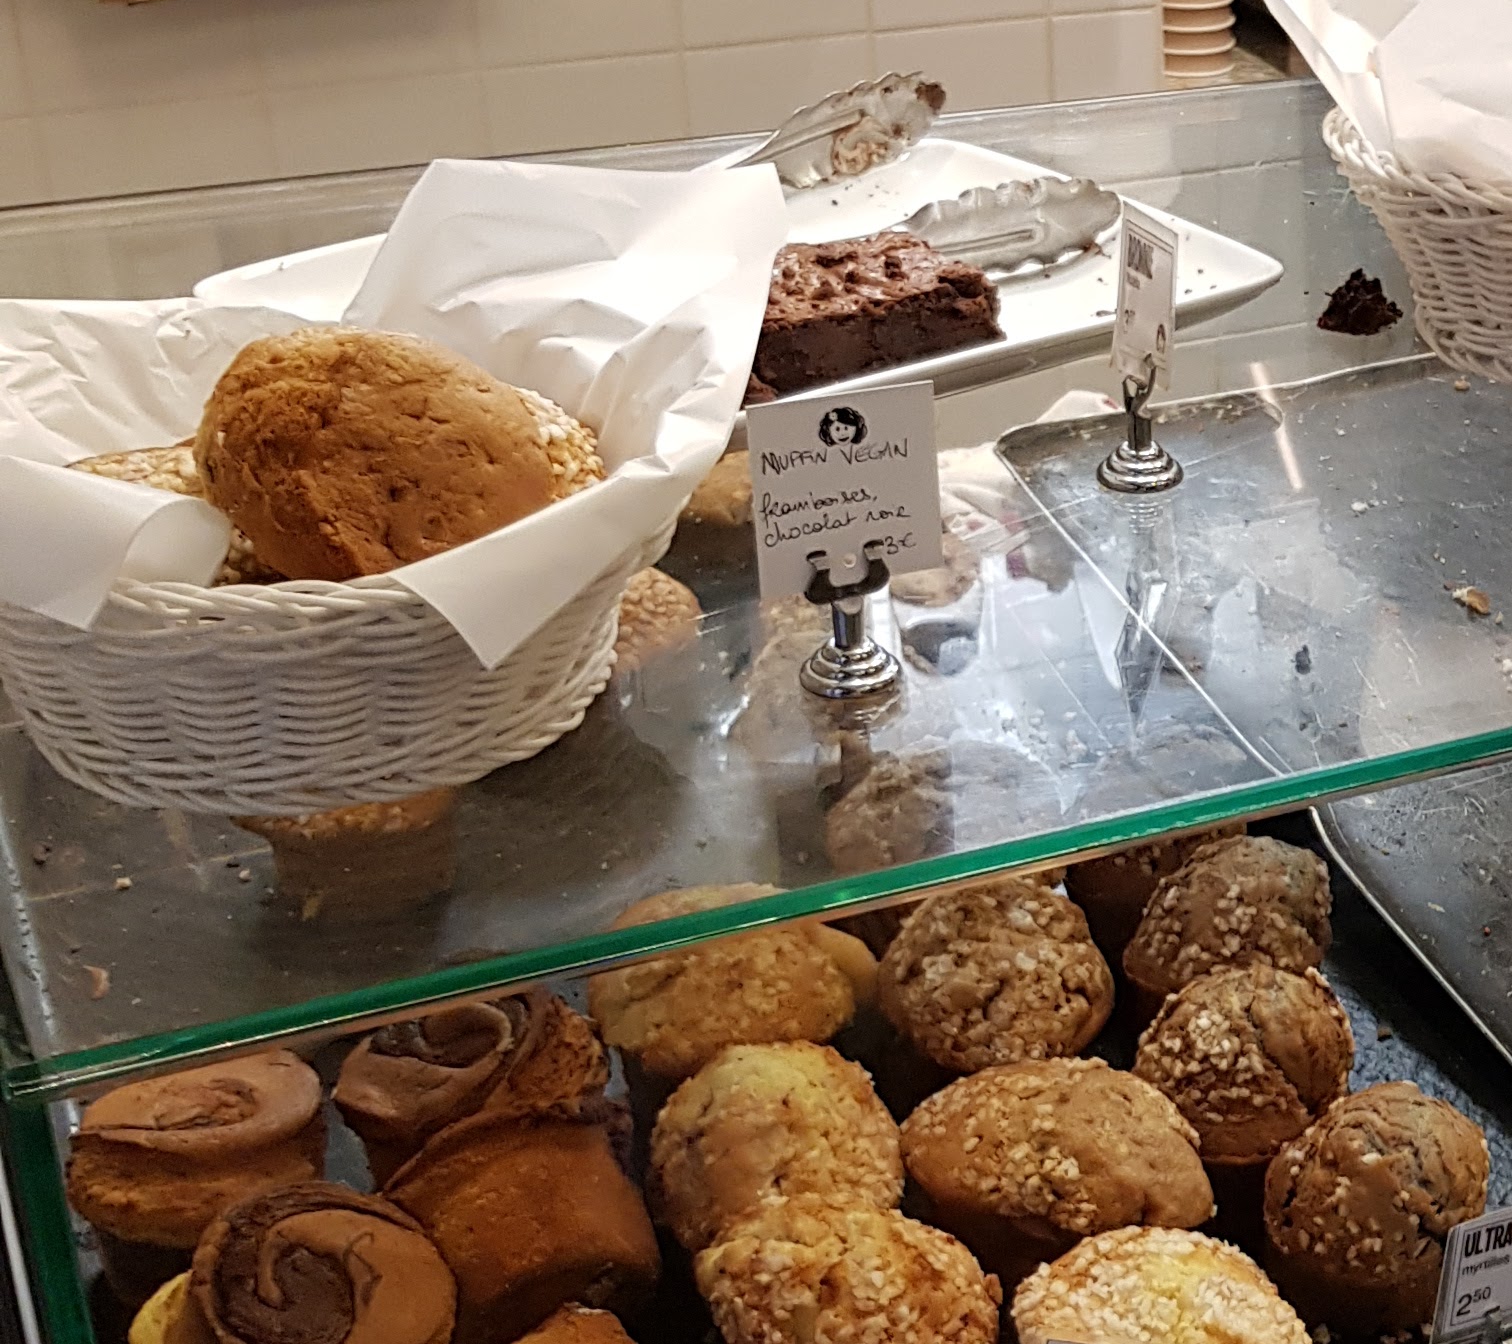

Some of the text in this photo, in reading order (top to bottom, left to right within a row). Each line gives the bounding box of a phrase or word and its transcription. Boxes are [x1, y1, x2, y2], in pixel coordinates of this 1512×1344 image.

[761, 437, 908, 476] MUFFIN VEGAN
[764, 511, 858, 548] chocolat
